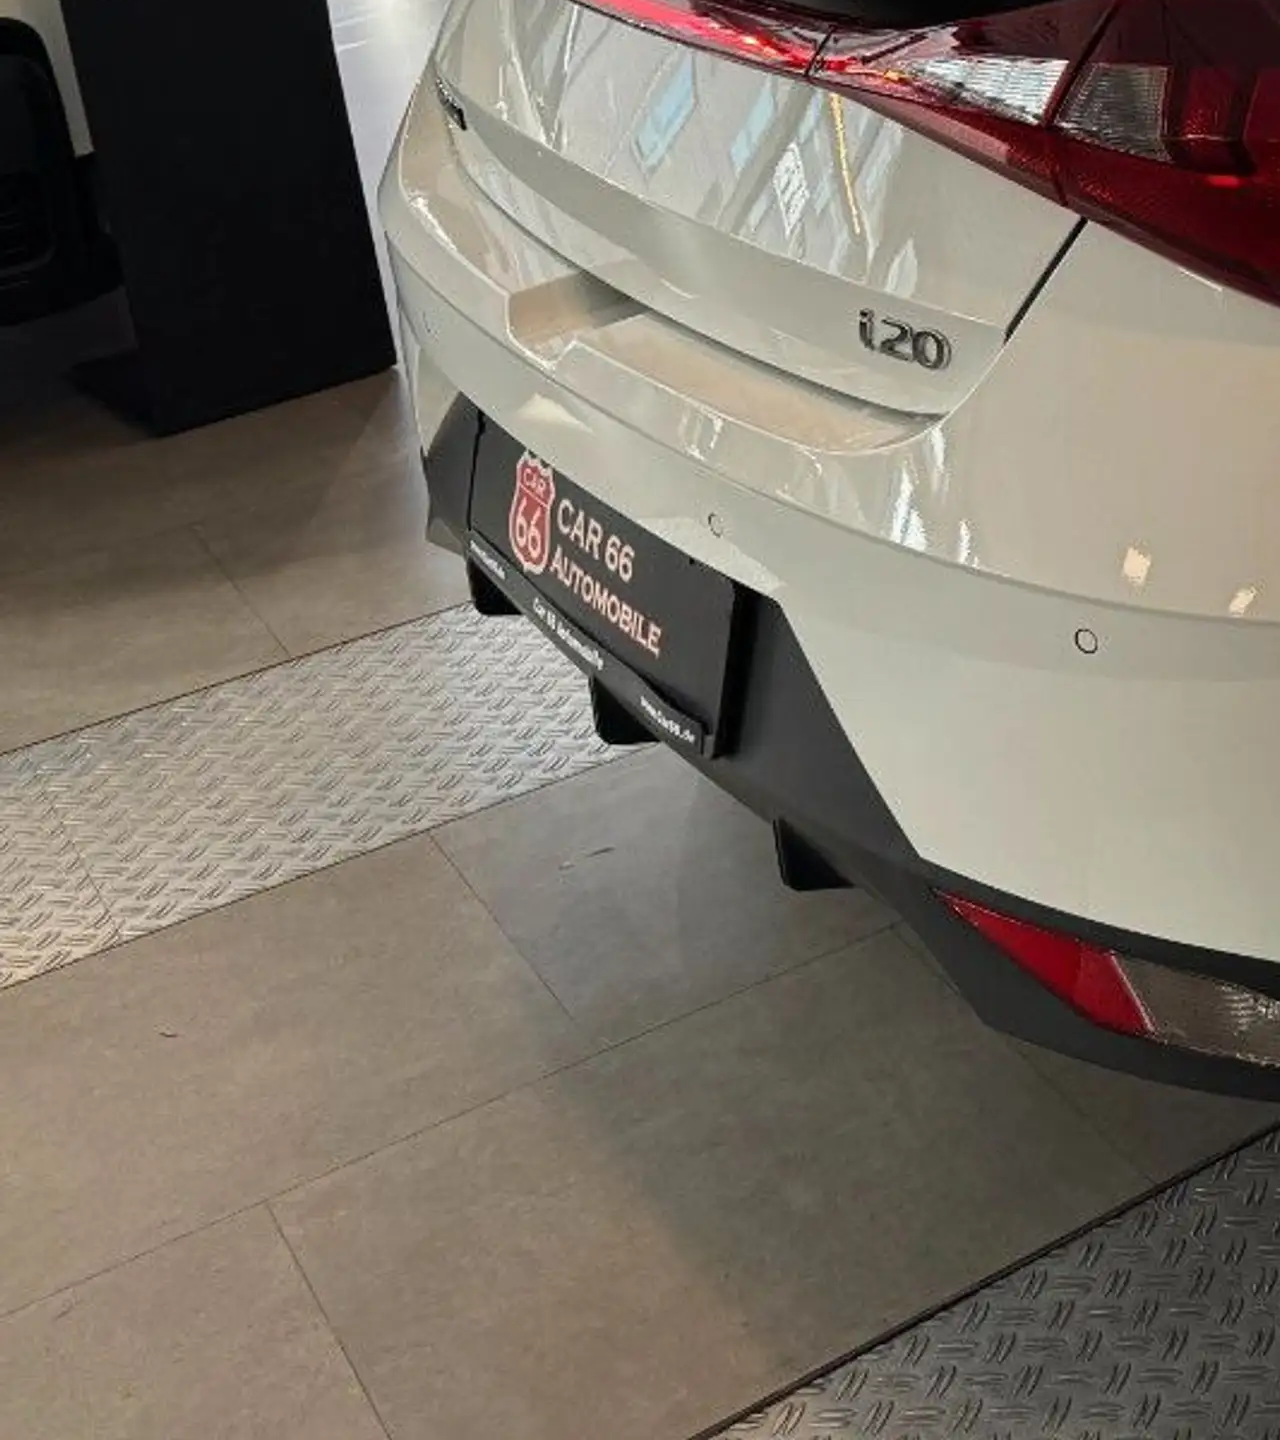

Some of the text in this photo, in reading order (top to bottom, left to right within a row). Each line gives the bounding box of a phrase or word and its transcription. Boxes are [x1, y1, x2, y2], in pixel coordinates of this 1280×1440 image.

[859, 307, 952, 371] i20
[523, 467, 546, 496] CAR
[515, 496, 542, 558] 66
[557, 499, 603, 561] CAR
[604, 534, 635, 583] 66
[550, 544, 662, 658] AUTOMOBILE
